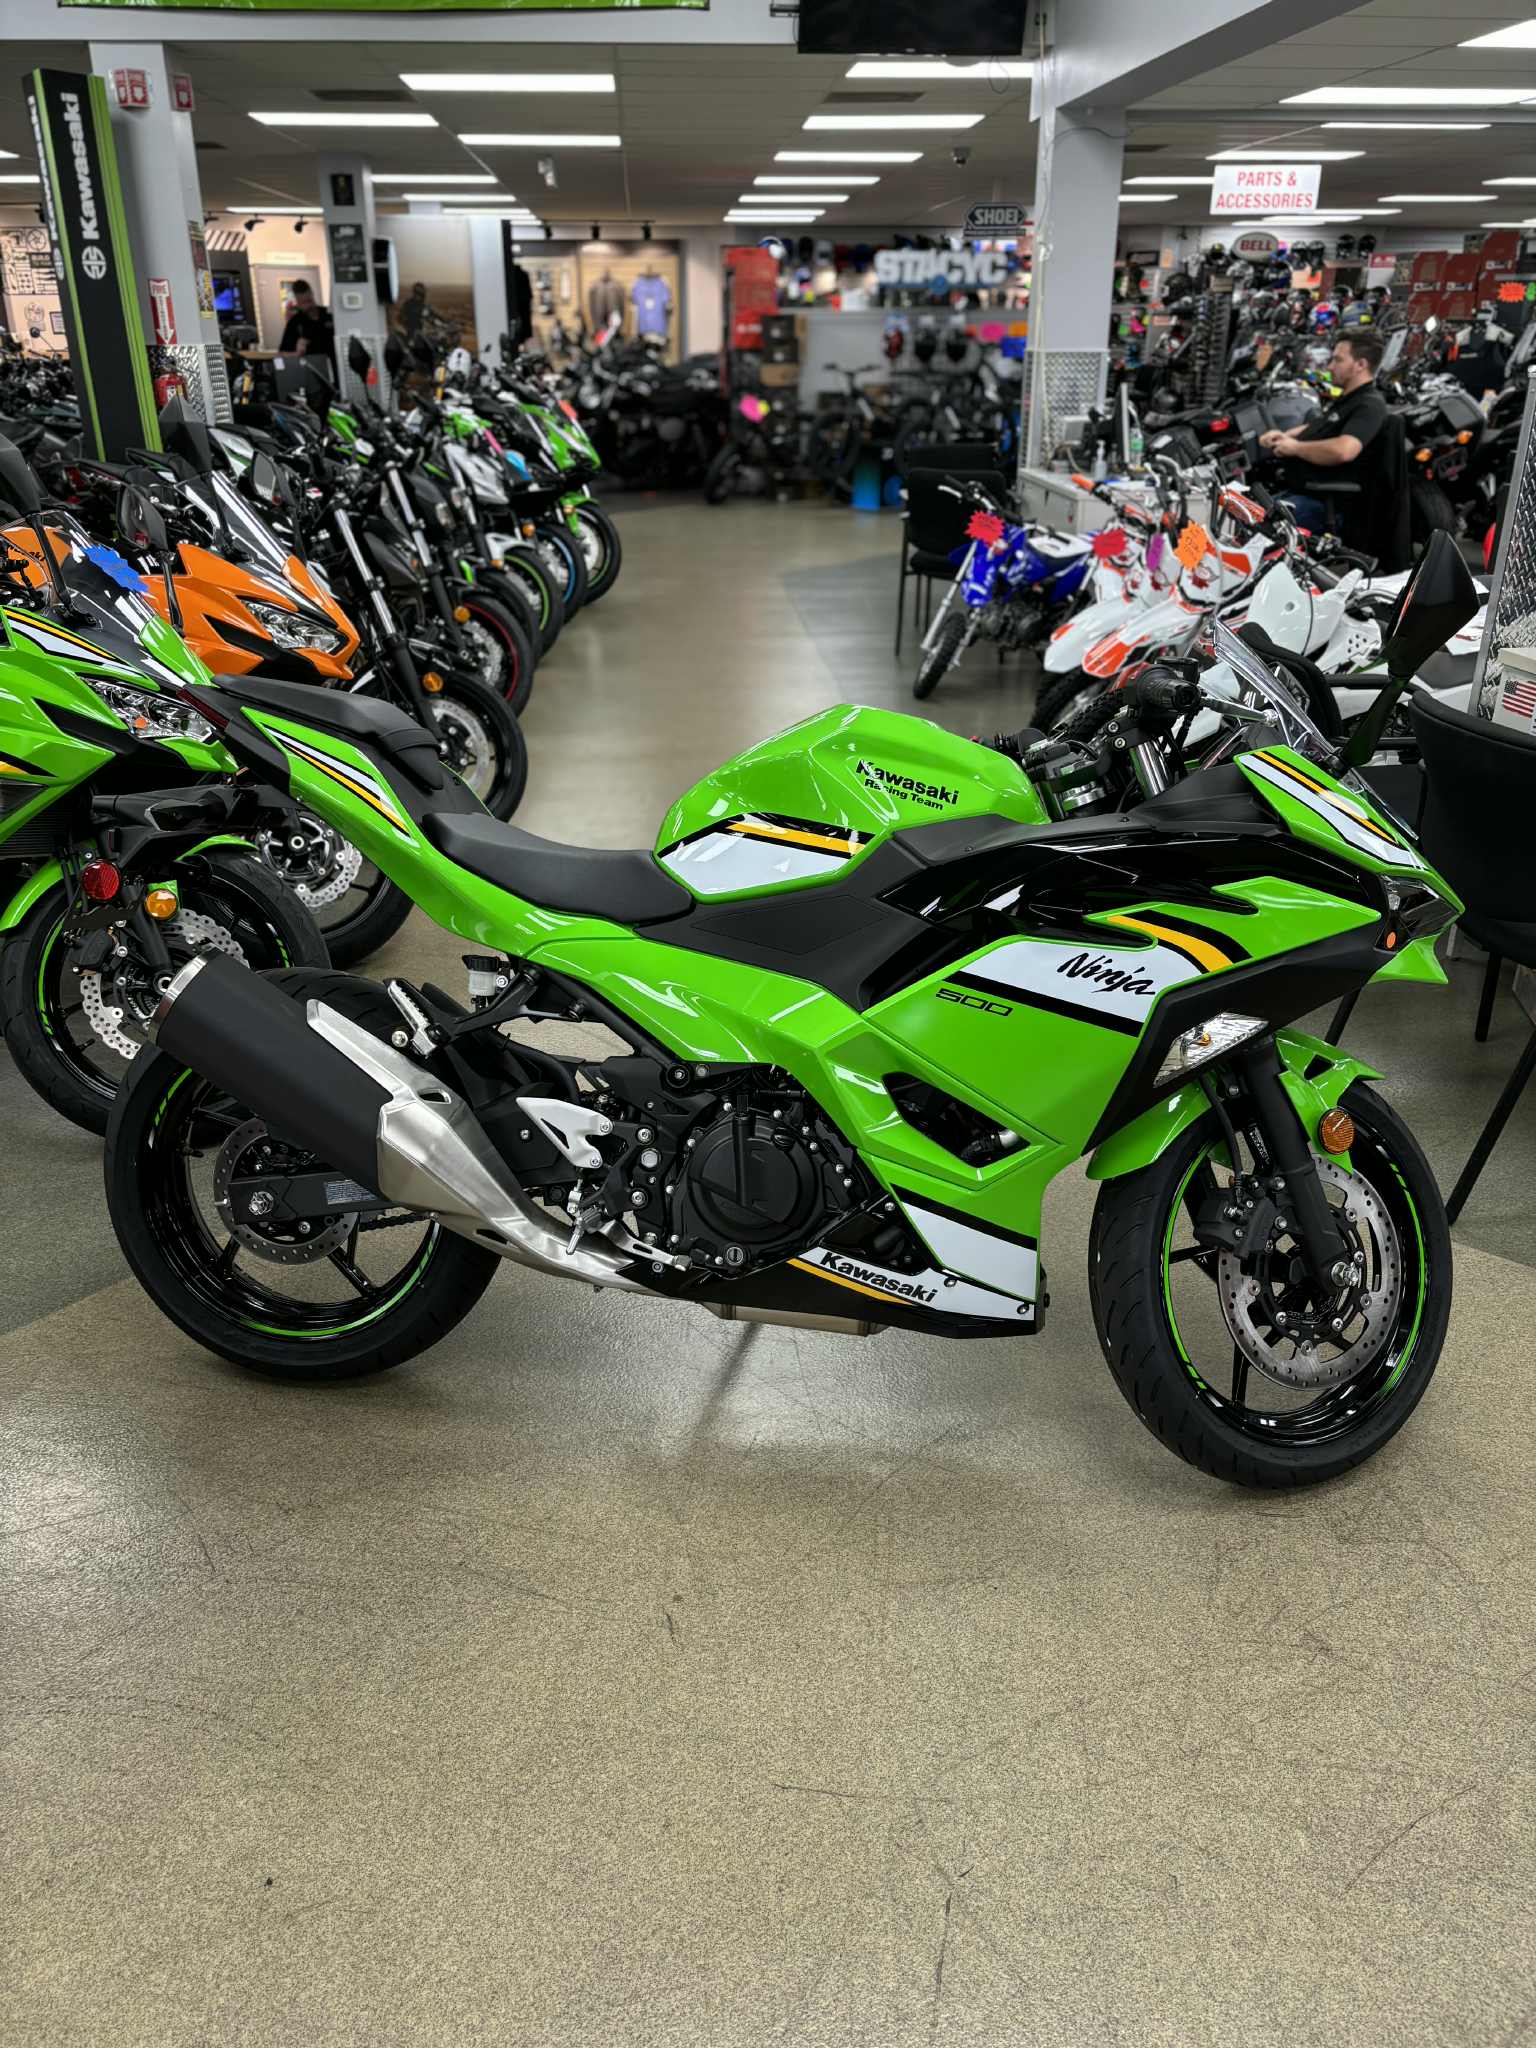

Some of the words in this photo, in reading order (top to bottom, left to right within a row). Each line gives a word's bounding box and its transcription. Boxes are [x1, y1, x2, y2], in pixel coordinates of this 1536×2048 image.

[60, 92, 100, 239] Kawasaki
[1237, 171, 1282, 186] PARTS
[1287, 171, 1297, 187] &
[1216, 193, 1313, 208] ACCESSORIES
[974, 208, 1018, 225] SHOEI
[1240, 240, 1274, 251] BELL
[874, 248, 1009, 284] STACYC
[856, 760, 959, 804] Kawasaki
[865, 779, 908, 800] Racing
[910, 792, 944, 810] Team
[1057, 952, 1156, 996] Ninja
[936, 987, 1013, 1016] 500
[820, 1251, 938, 1302] Kawasaki
